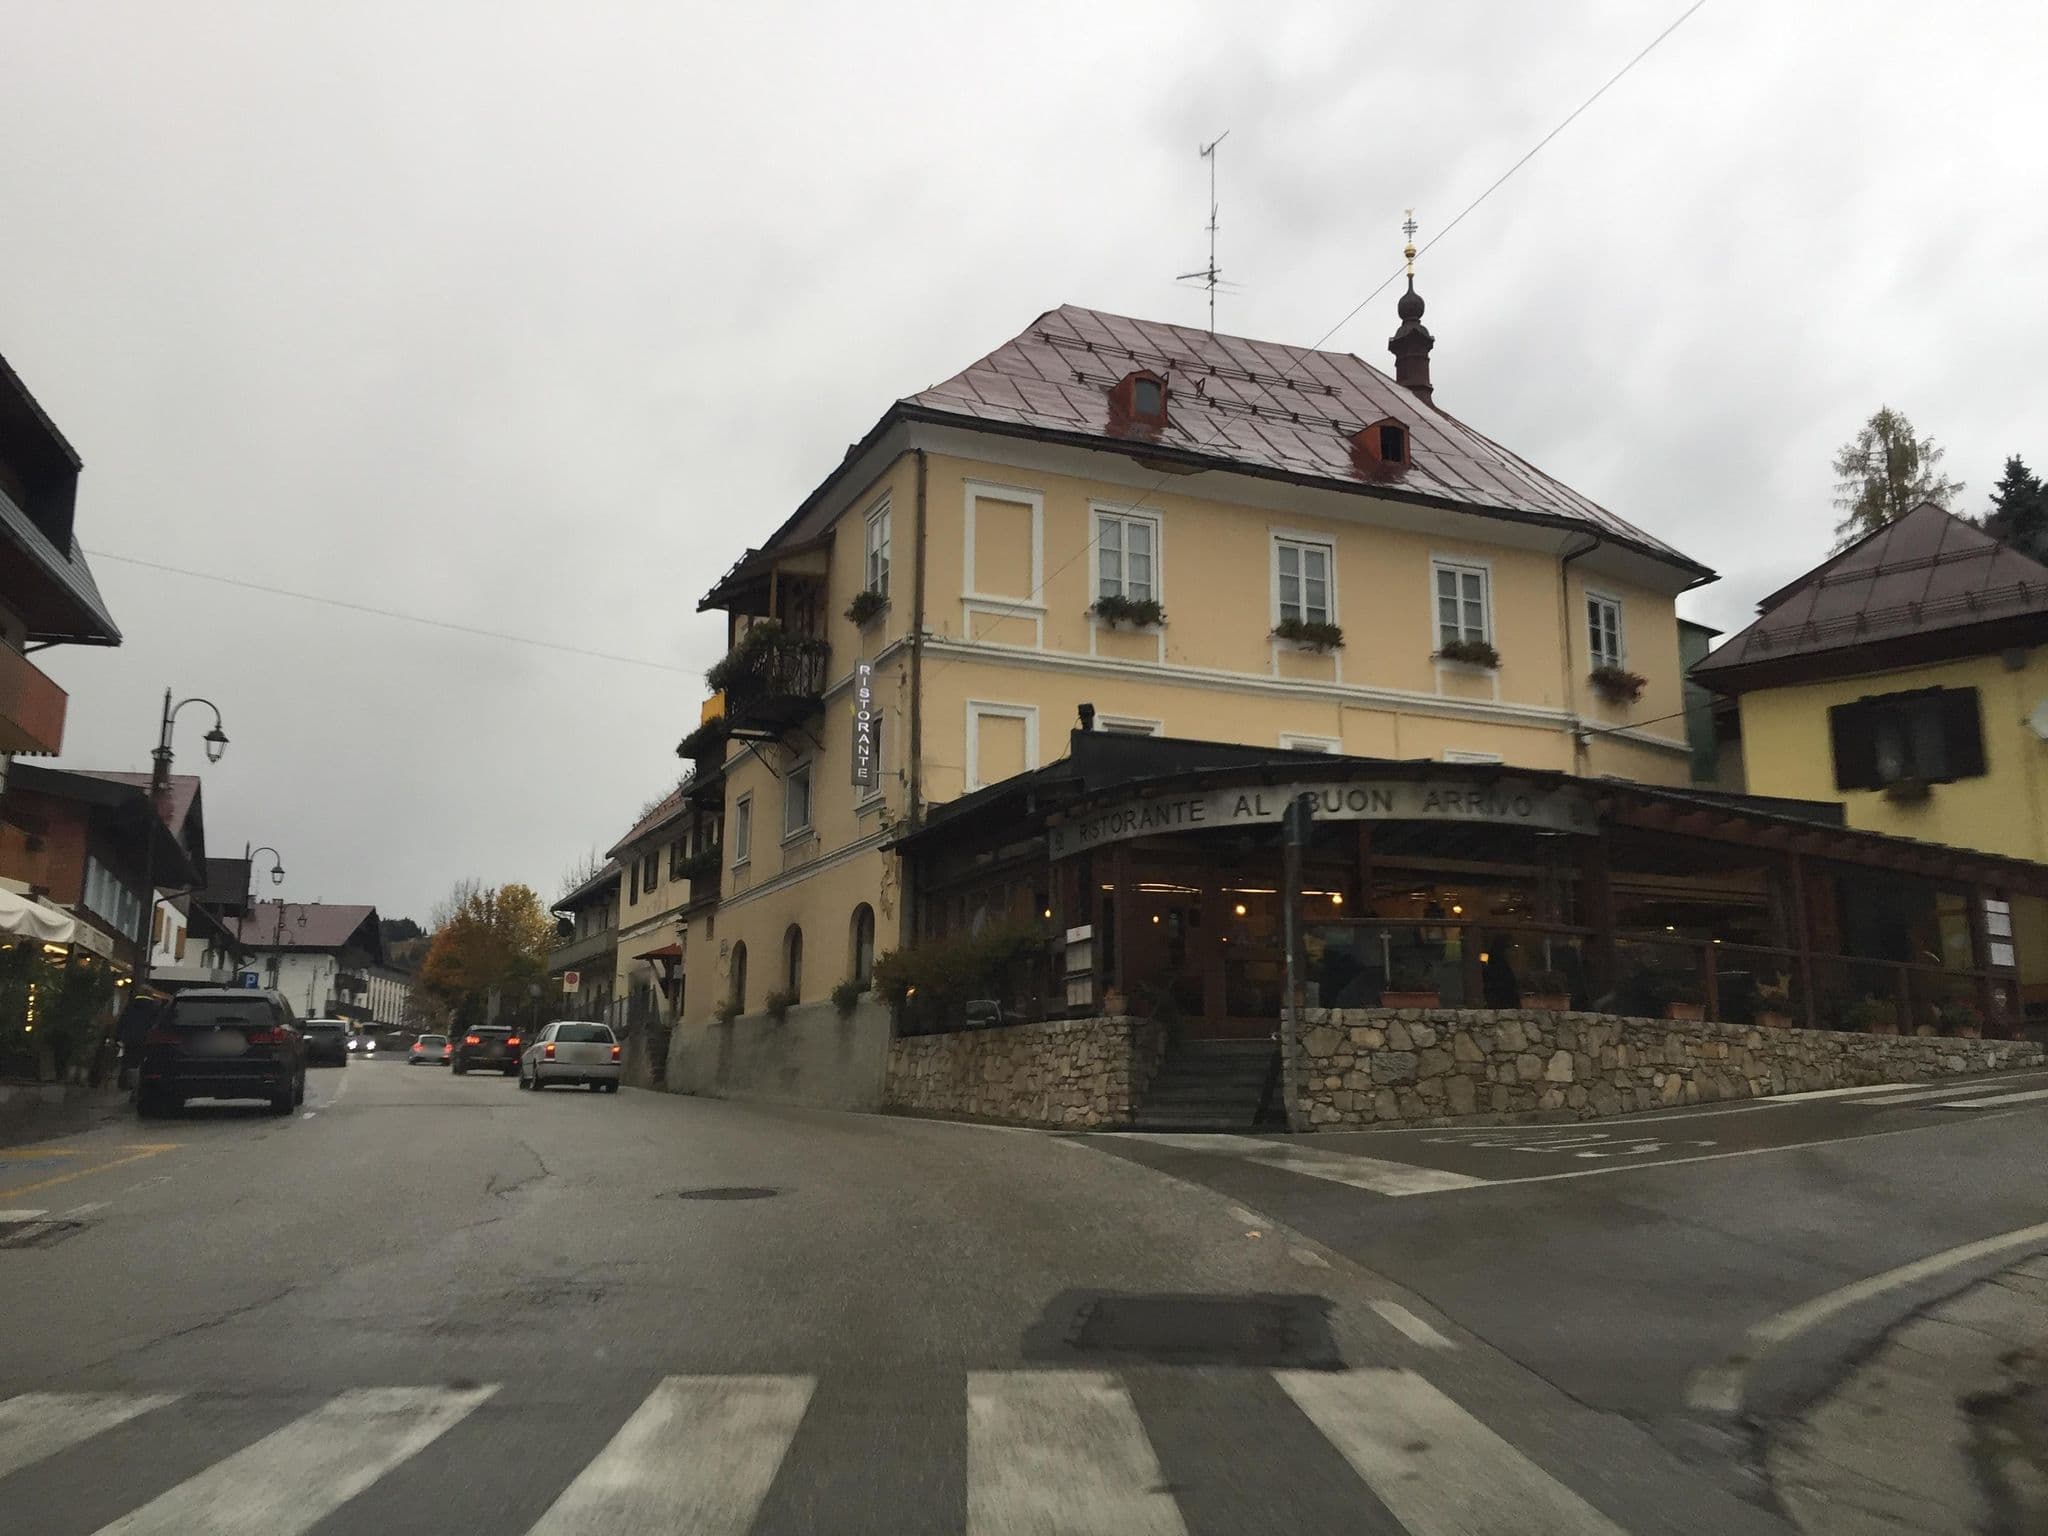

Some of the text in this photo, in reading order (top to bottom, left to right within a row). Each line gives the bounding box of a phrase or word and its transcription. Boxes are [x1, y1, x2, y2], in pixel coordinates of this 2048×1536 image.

[857, 665, 870, 778] RISTORANTE
[1079, 800, 1205, 844] RISTORANTE
[1232, 794, 1272, 817] AL
